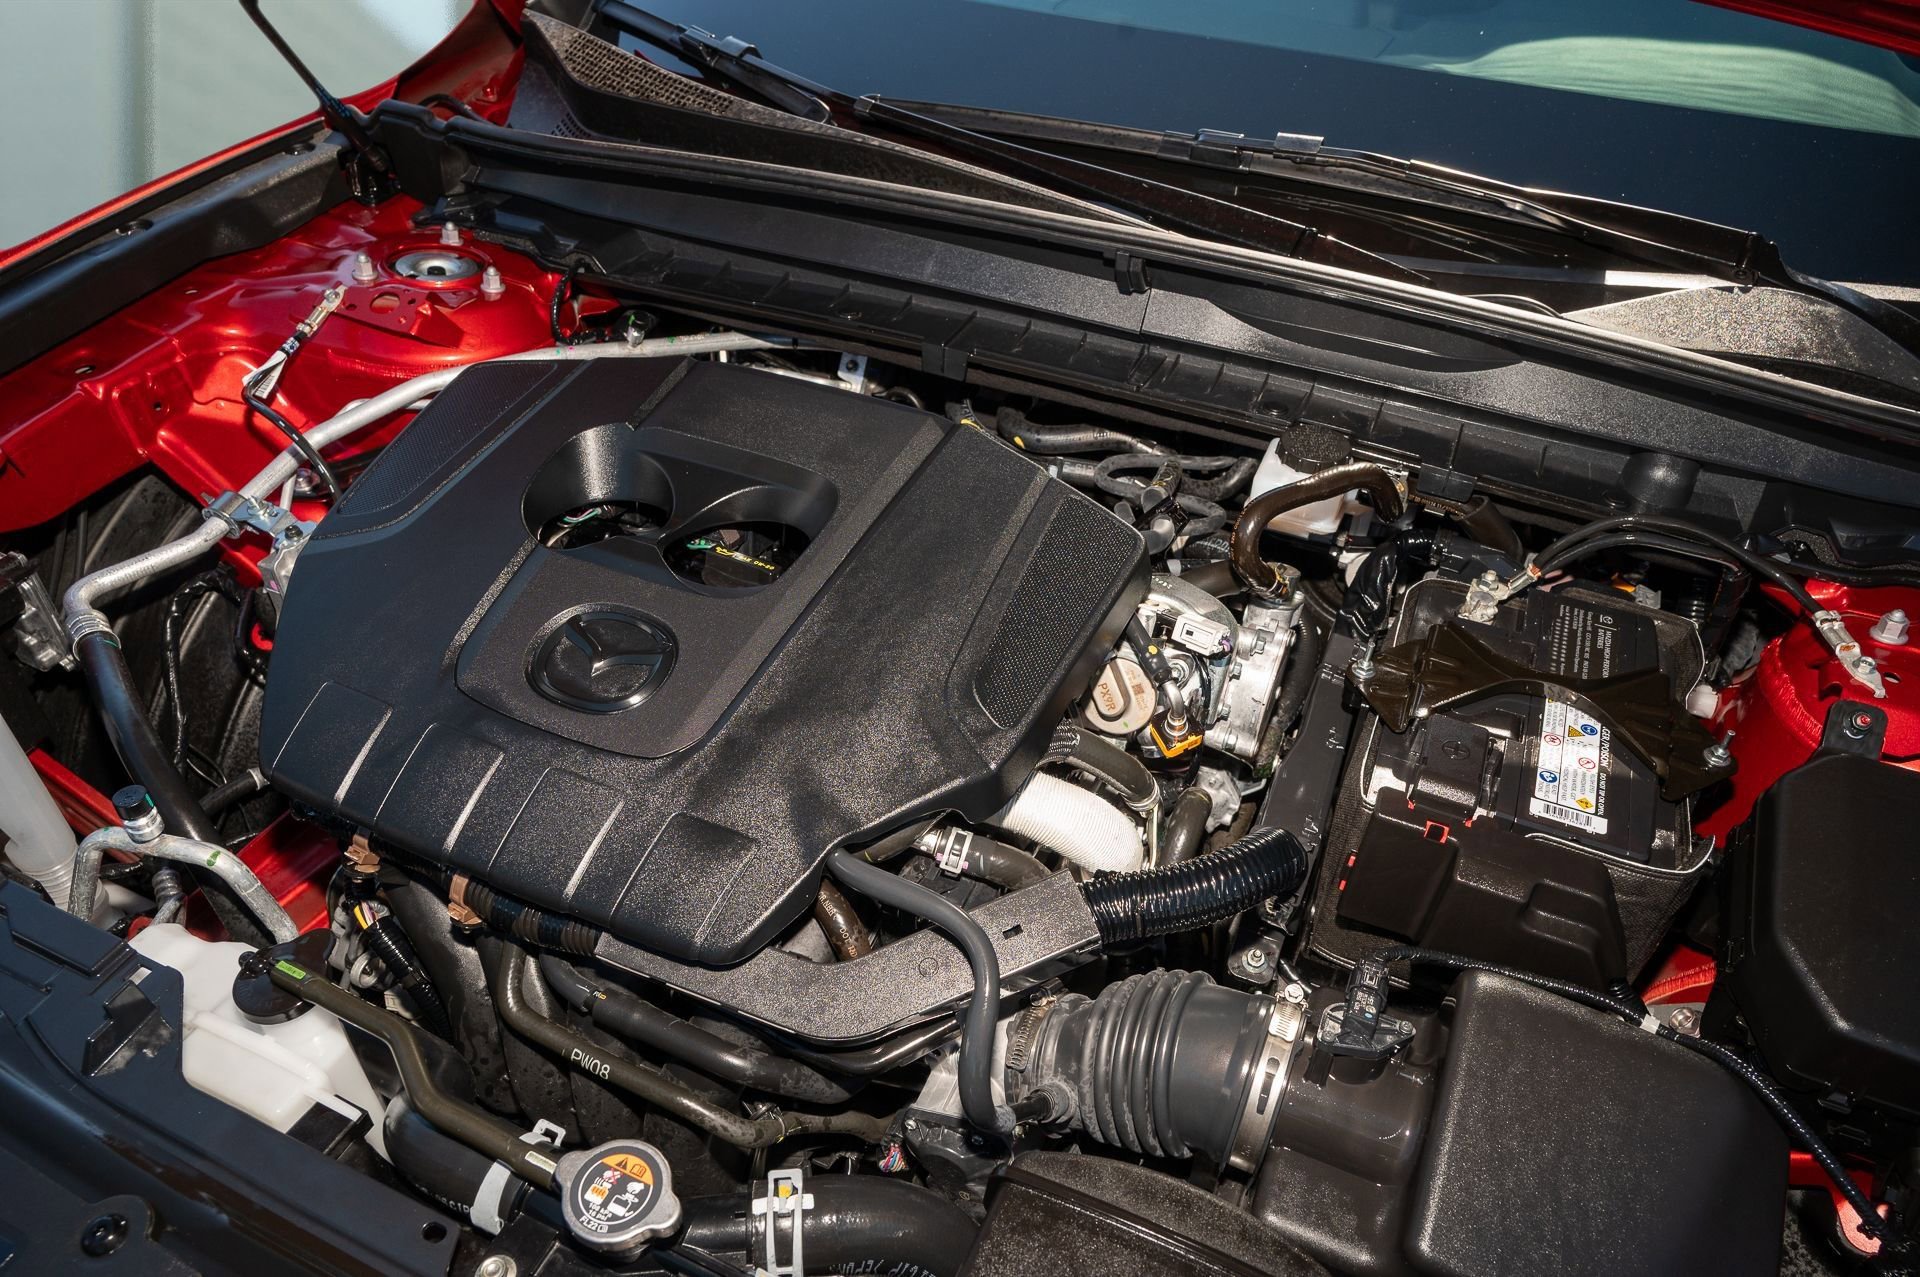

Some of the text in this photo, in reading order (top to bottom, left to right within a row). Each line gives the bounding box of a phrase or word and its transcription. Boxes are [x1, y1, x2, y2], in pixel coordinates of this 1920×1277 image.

[1098, 682, 1116, 711] PX9R
[1600, 726, 1611, 767] GER/POISON
[840, 927, 852, 944] DOT
[570, 1048, 610, 1080] PW08
[579, 1215, 598, 1230] FL22
[600, 1208, 612, 1218] kPa
